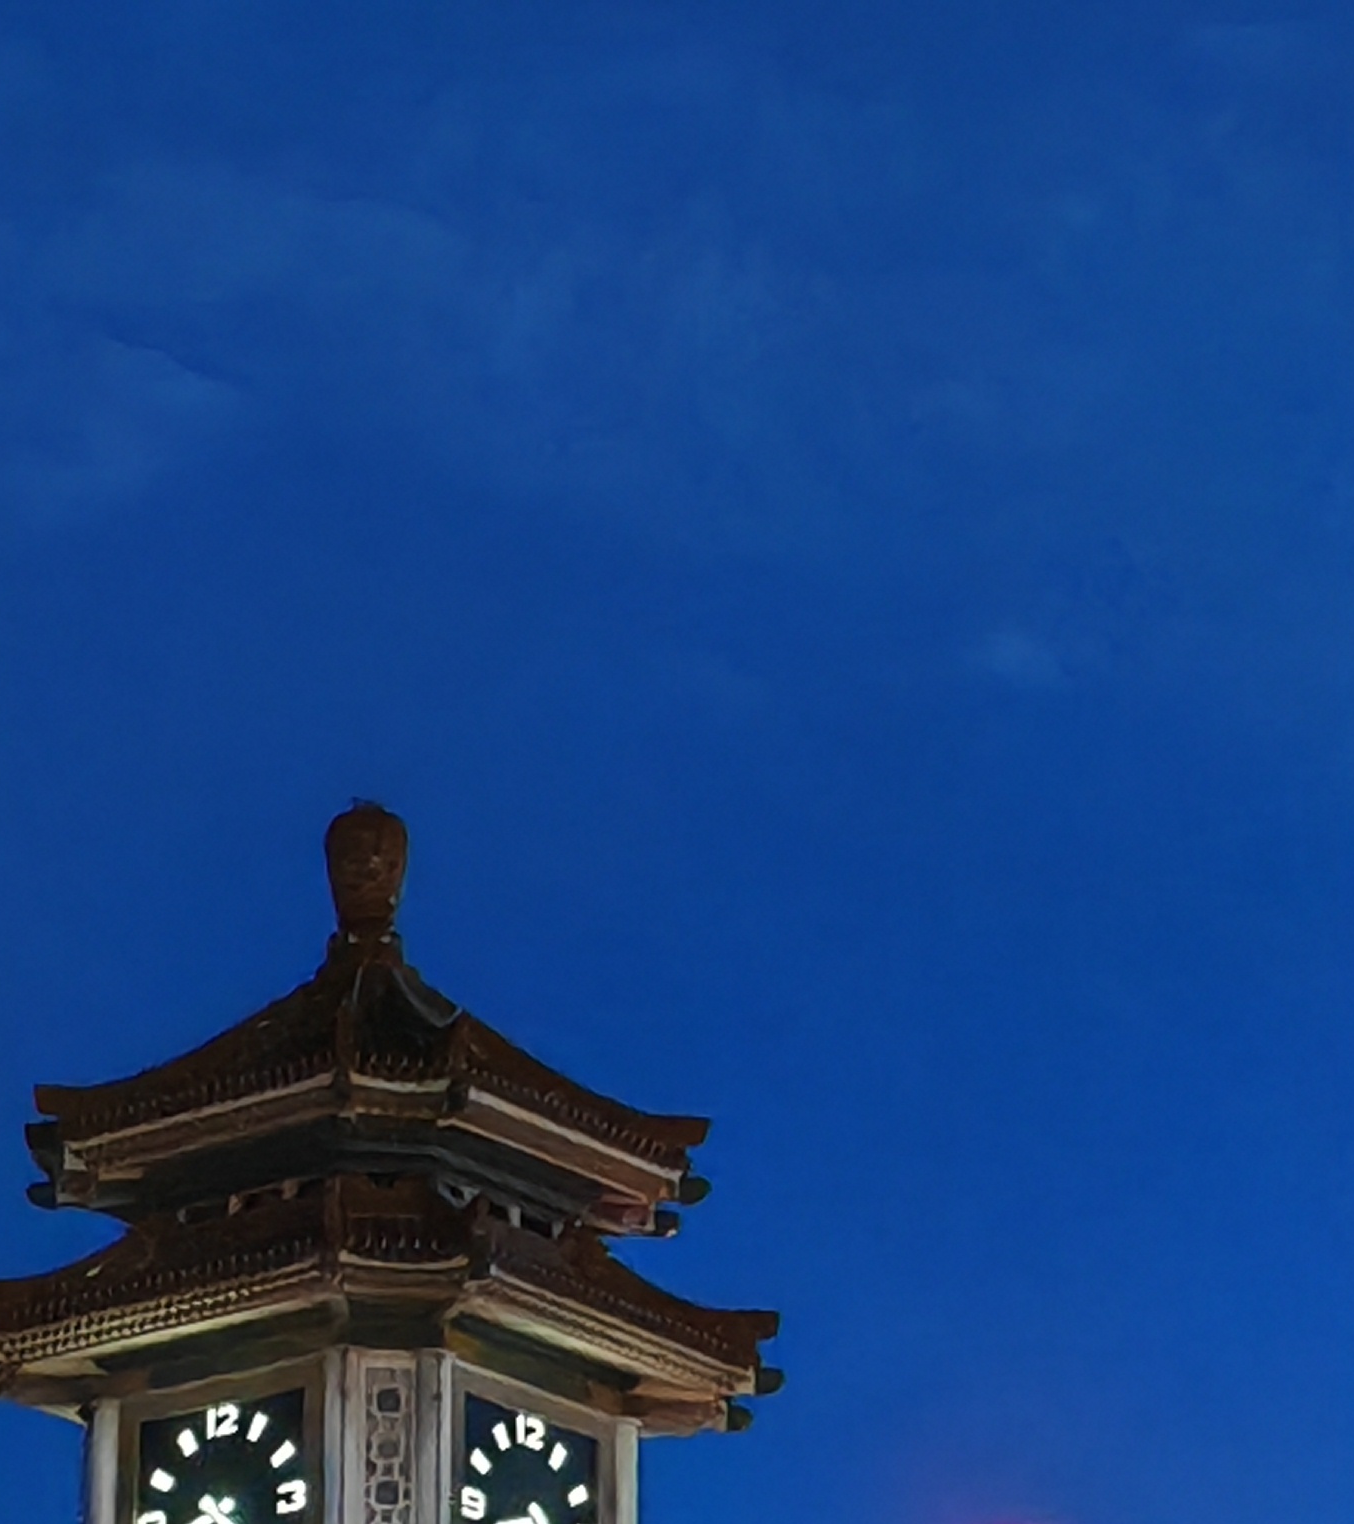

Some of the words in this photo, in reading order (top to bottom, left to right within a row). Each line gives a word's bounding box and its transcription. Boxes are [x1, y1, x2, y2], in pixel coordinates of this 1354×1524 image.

[206, 1402, 240, 1440] 12
[515, 1412, 546, 1451] 12
[276, 1479, 307, 1515] 3
[460, 1485, 487, 1521] 9
